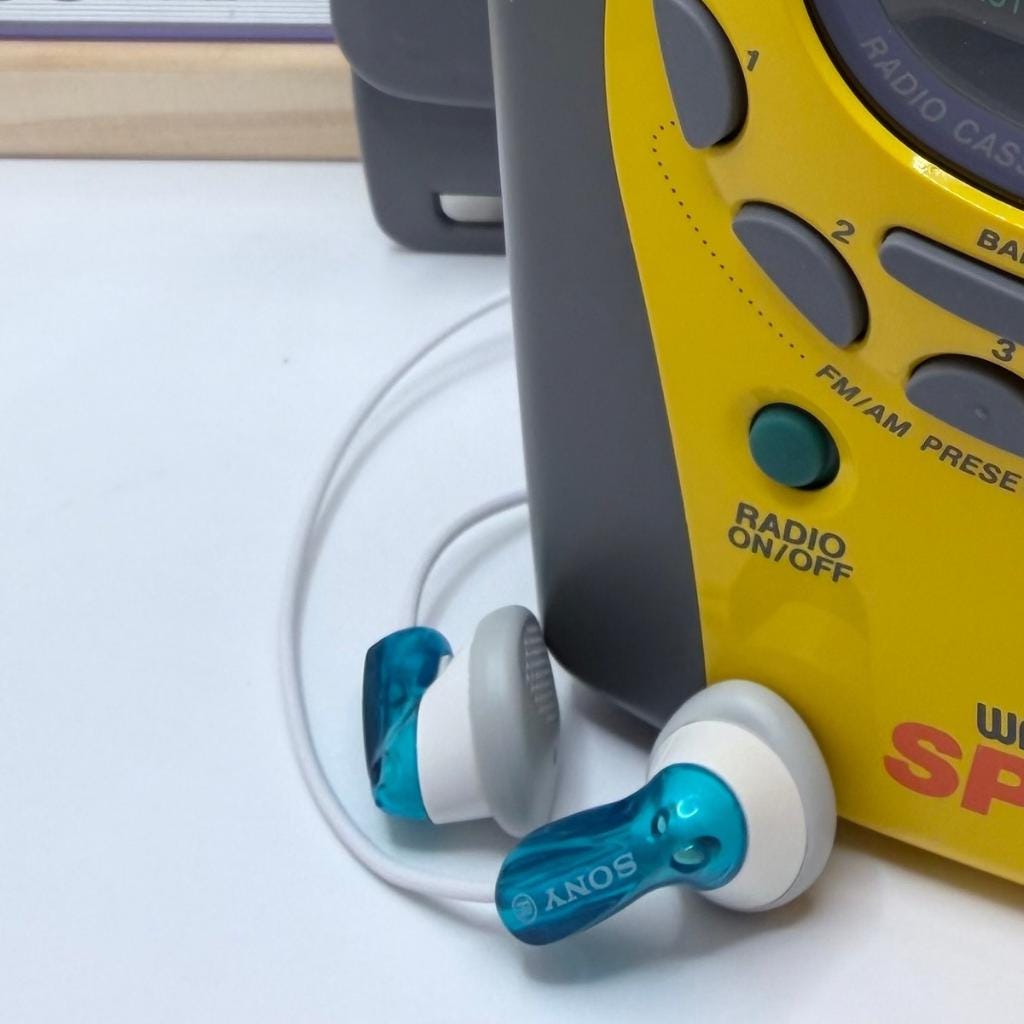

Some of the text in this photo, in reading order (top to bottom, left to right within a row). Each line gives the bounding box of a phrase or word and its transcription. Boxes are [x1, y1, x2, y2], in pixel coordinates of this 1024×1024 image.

[744, 48, 761, 72] 1
[860, 36, 948, 124] RADIO
[832, 219, 858, 246] 2
[991, 338, 1018, 364] 3
[814, 364, 913, 438] FM/AM
[727, 525, 855, 583] ON/OFF
[735, 501, 847, 559] RADIO
[545, 852, 638, 912] SONY
